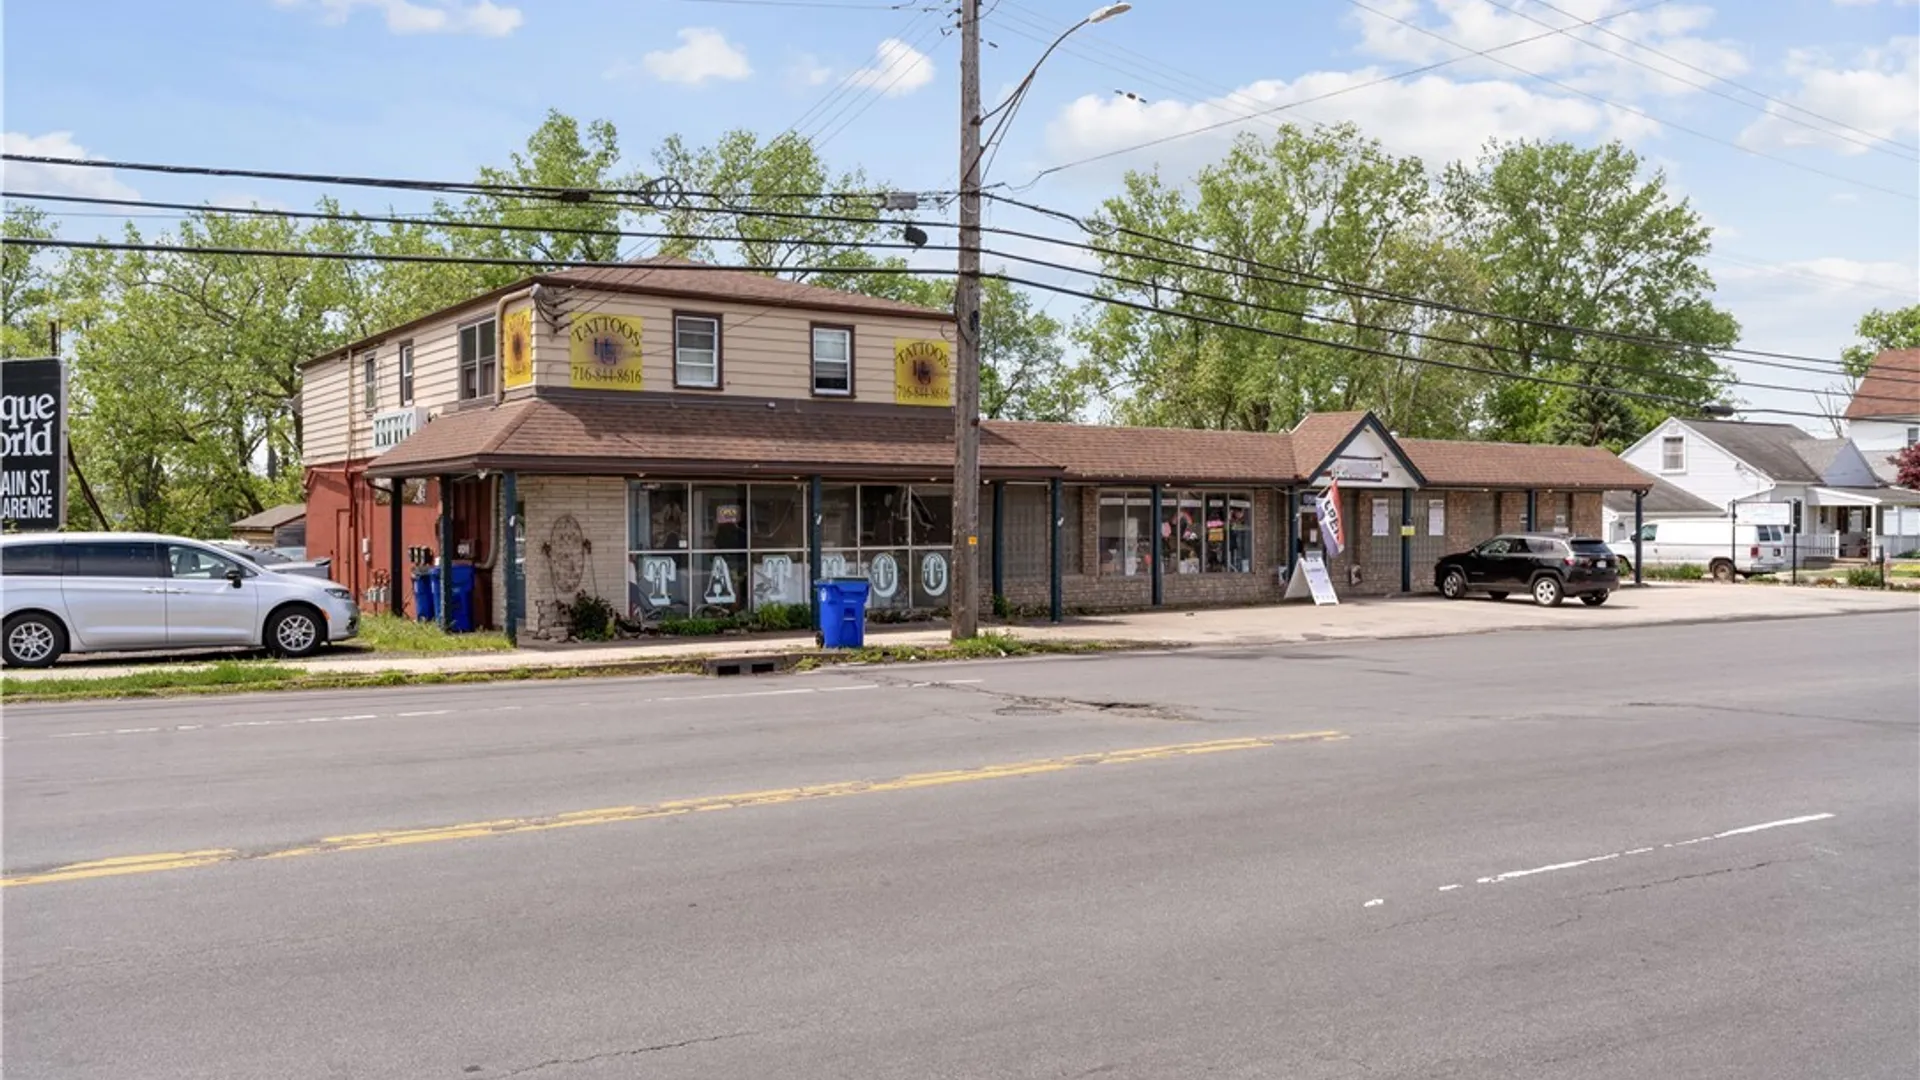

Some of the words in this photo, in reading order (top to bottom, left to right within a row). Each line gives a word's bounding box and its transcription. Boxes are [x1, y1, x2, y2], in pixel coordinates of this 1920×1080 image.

[571, 316, 641, 347] TATTOOS
[896, 342, 949, 368] TATTOOS
[30, 469, 52, 495] ST.
